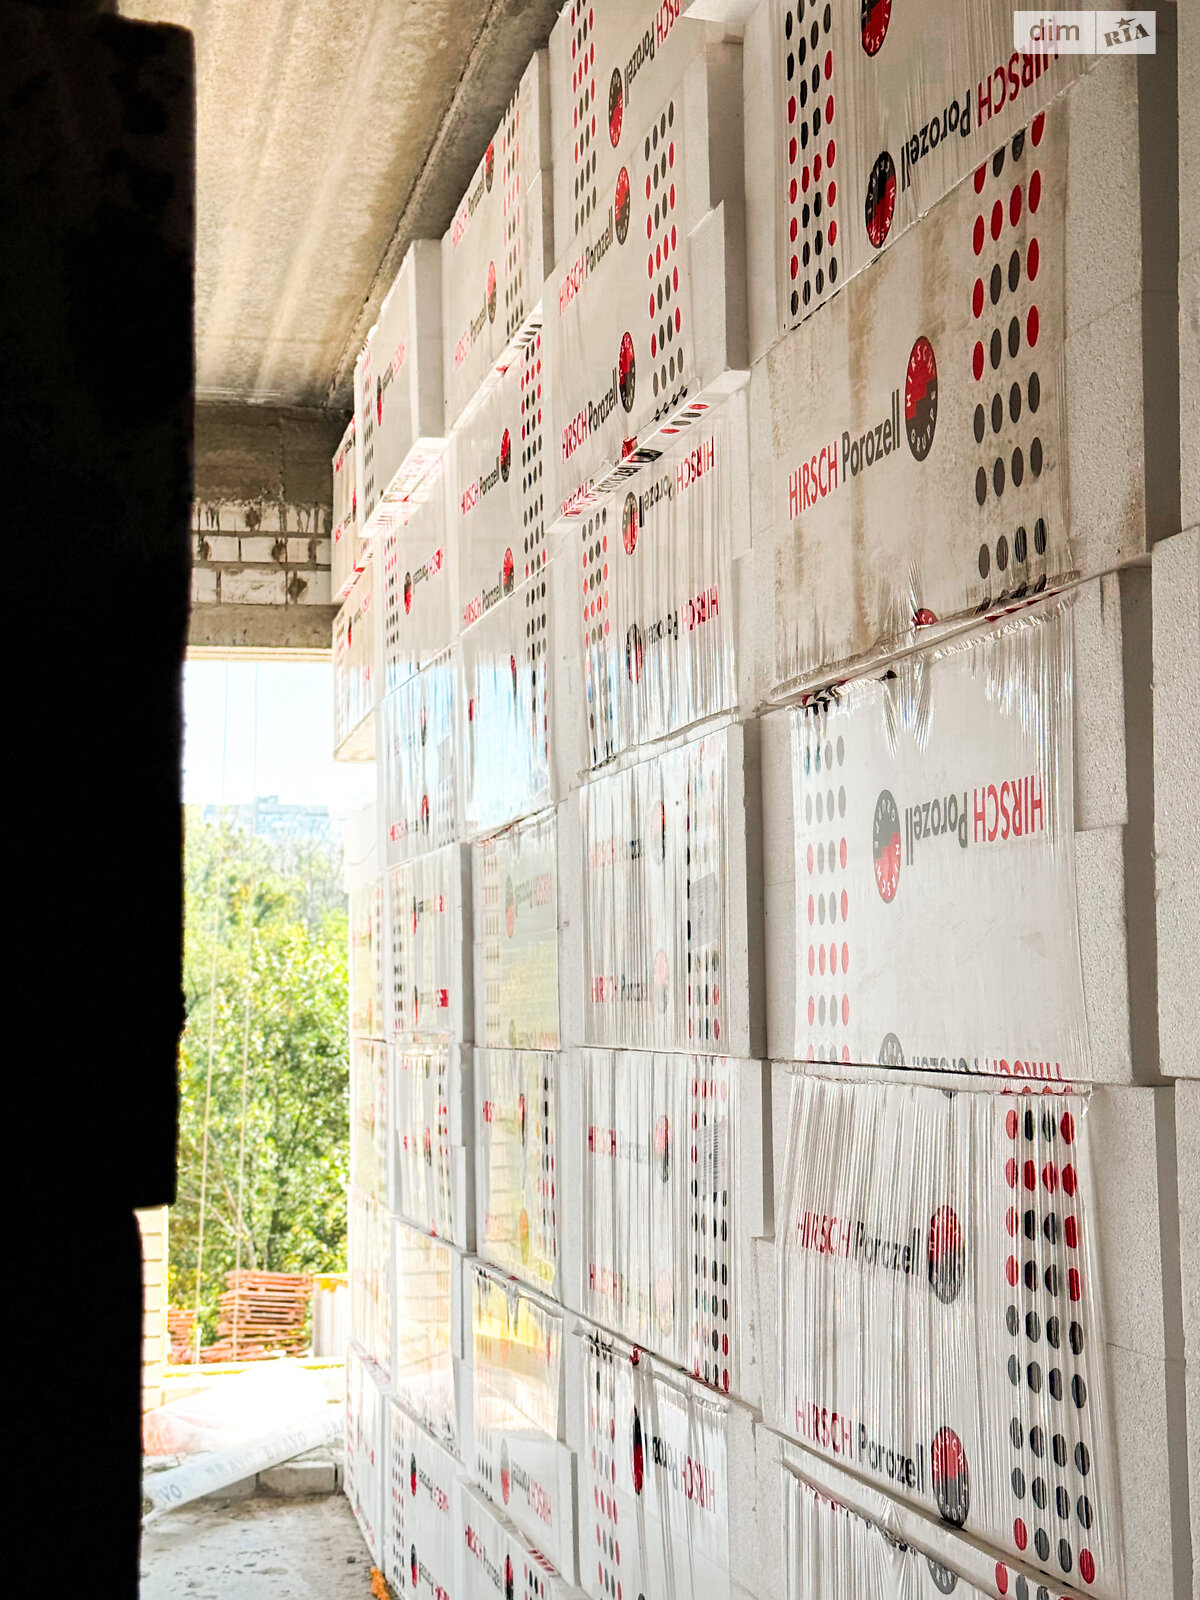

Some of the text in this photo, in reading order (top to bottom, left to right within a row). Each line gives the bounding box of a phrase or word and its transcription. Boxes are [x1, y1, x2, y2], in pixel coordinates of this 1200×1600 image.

[901, 89, 971, 193] Porozell
[561, 407, 588, 464] HIRSCH
[588, 367, 619, 435] Porozell
[788, 389, 901, 520] HIRSCH Porozell
[676, 436, 714, 494] HIRSCH
[906, 772, 1044, 866] HIRSCH Porozell
[796, 1211, 851, 1259] HIRSCH
[855, 1221, 921, 1277] Porozell
[796, 1395, 925, 1494] HIRSCH Porozell
